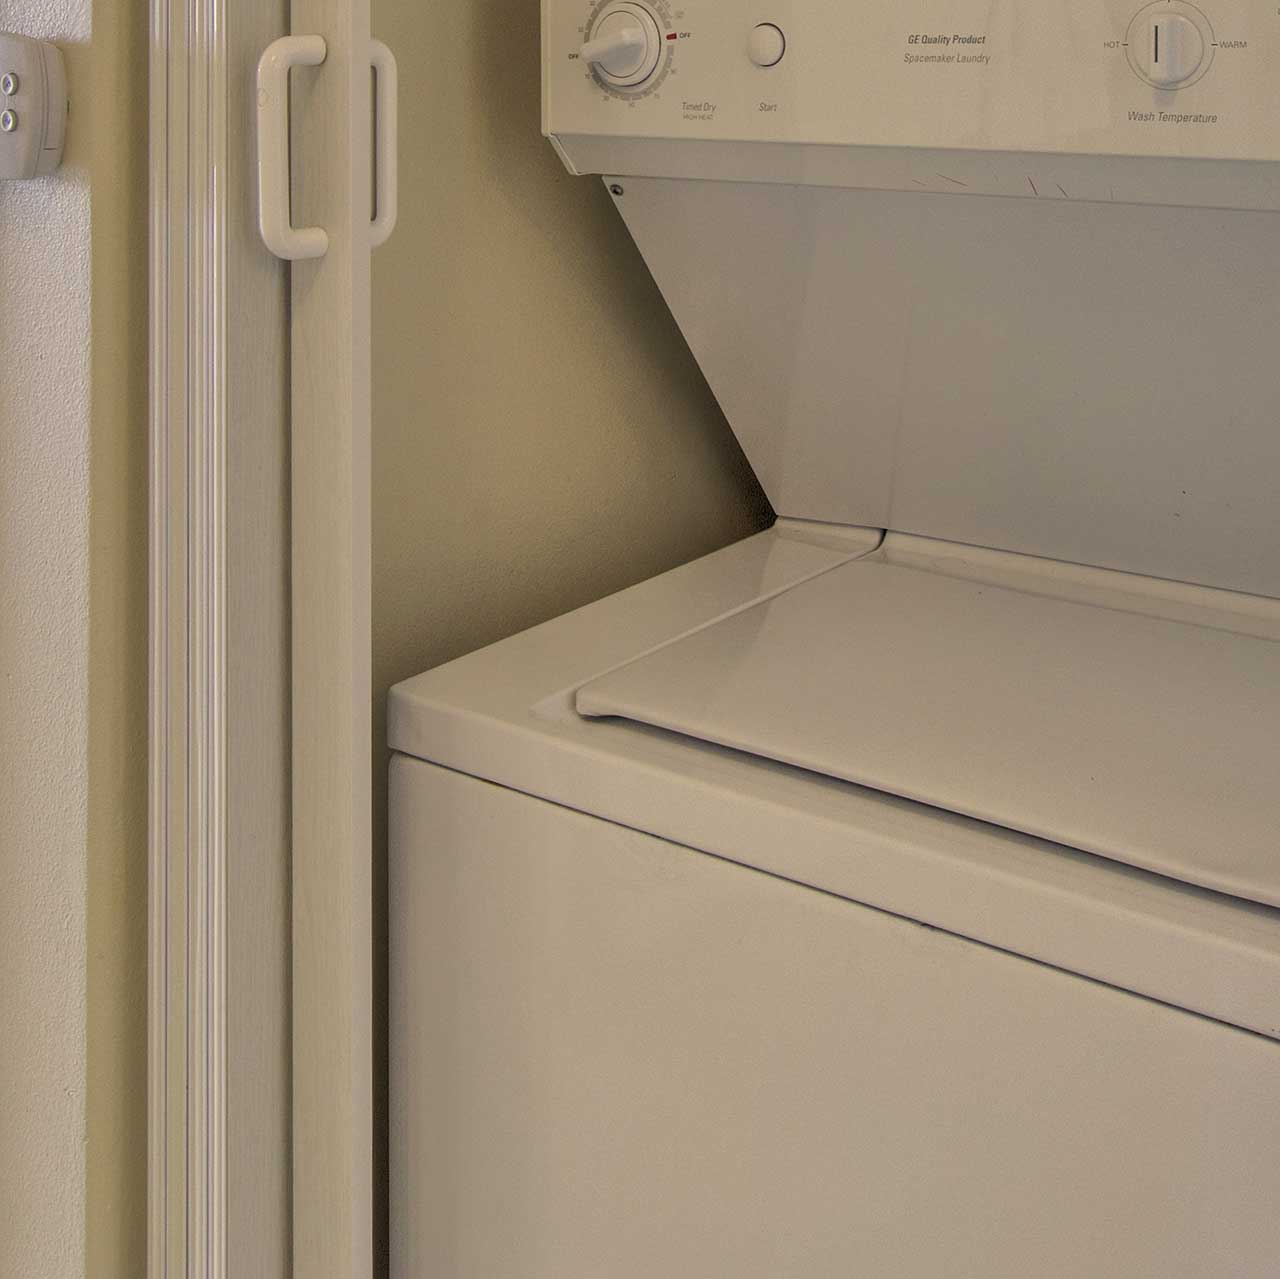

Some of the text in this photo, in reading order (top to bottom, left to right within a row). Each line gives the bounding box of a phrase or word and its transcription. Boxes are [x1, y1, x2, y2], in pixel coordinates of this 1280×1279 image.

[908, 34, 986, 46] GE Quality Product
[904, 53, 990, 64] Spacemaker Laundry
[682, 102, 716, 113] Timed Dry
[759, 102, 777, 112] Start
[1128, 112, 1217, 124] Wash Temperature
